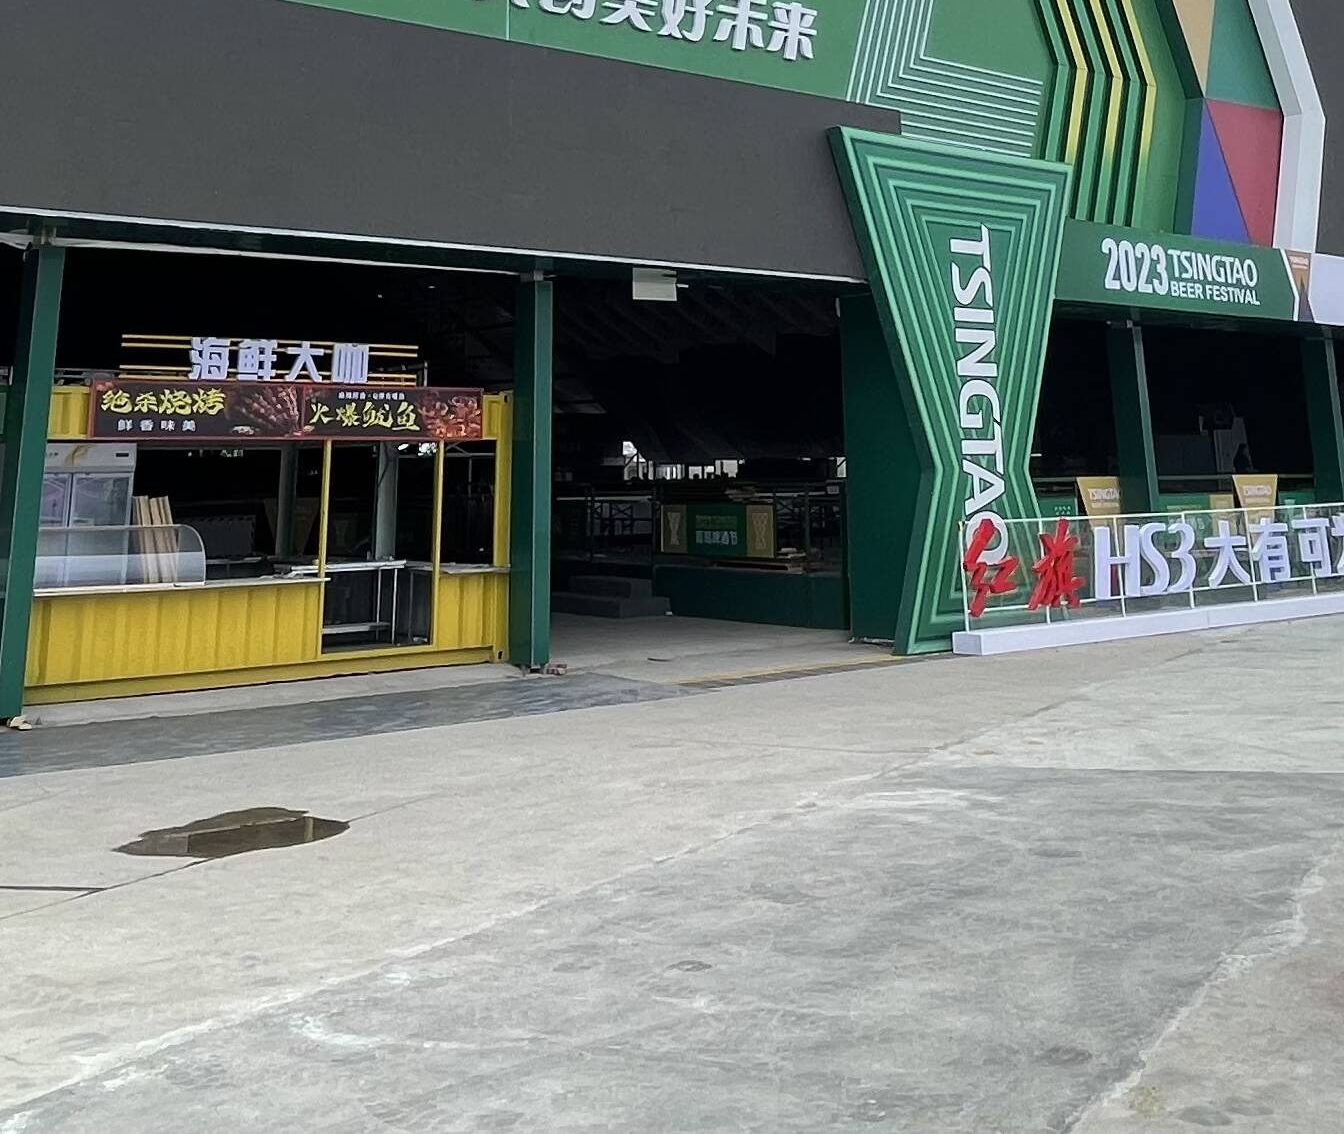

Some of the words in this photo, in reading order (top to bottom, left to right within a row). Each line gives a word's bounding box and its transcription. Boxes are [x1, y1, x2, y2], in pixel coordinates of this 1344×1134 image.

[1101, 237, 1168, 296] 2023
[1168, 248, 1258, 287] TSINGTAO
[1170, 282, 1203, 300] BEER
[1205, 285, 1260, 306] FESTIVAL
[187, 336, 370, 383] 海鲜大咖
[101, 387, 227, 415] 绝杀烧烤
[309, 401, 421, 431] 火爆鱿鱼
[948, 222, 1008, 566] TSINGTAO
[1094, 521, 1196, 601] HS3
